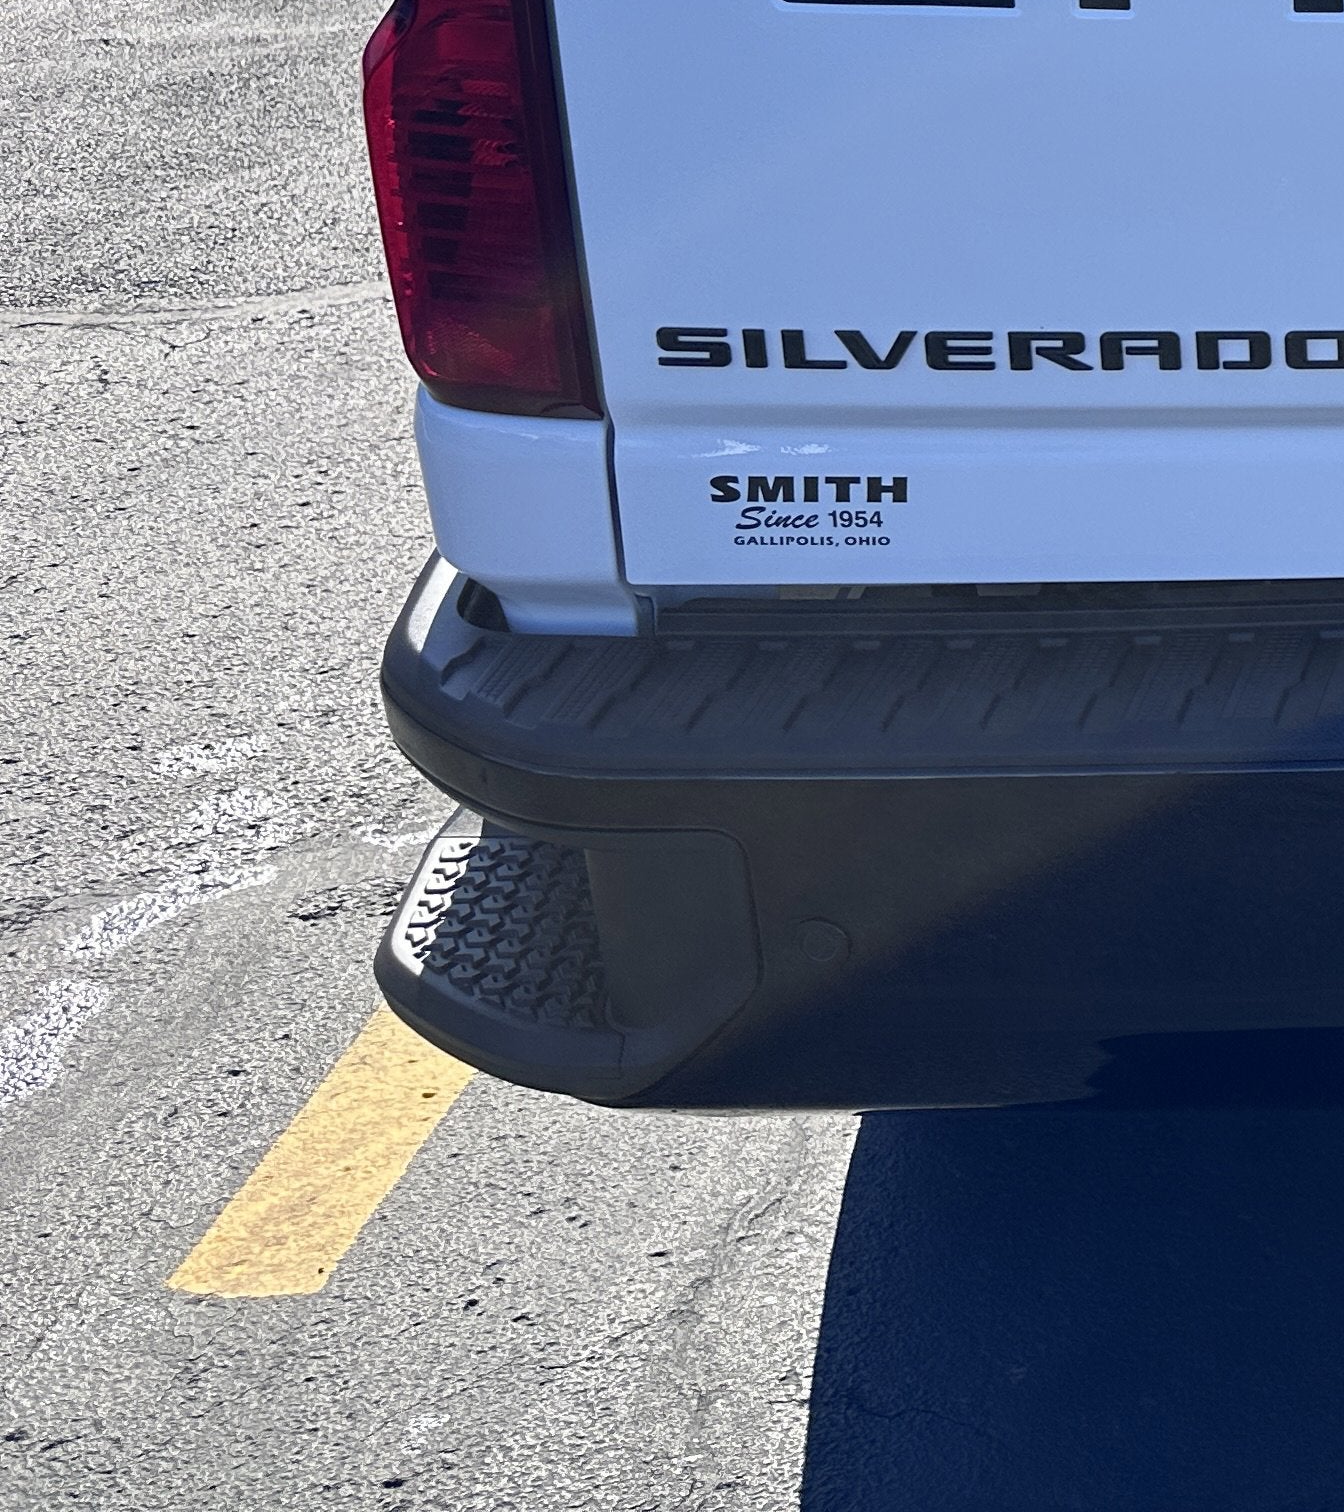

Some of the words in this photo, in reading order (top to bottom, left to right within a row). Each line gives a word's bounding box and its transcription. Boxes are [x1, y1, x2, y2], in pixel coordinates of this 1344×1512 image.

[709, 475, 908, 503] SMITH
[735, 506, 820, 530] Since
[827, 510, 883, 528] 1954
[733, 536, 840, 547] GALLIPOLIS,
[844, 536, 891, 546] OHIO
